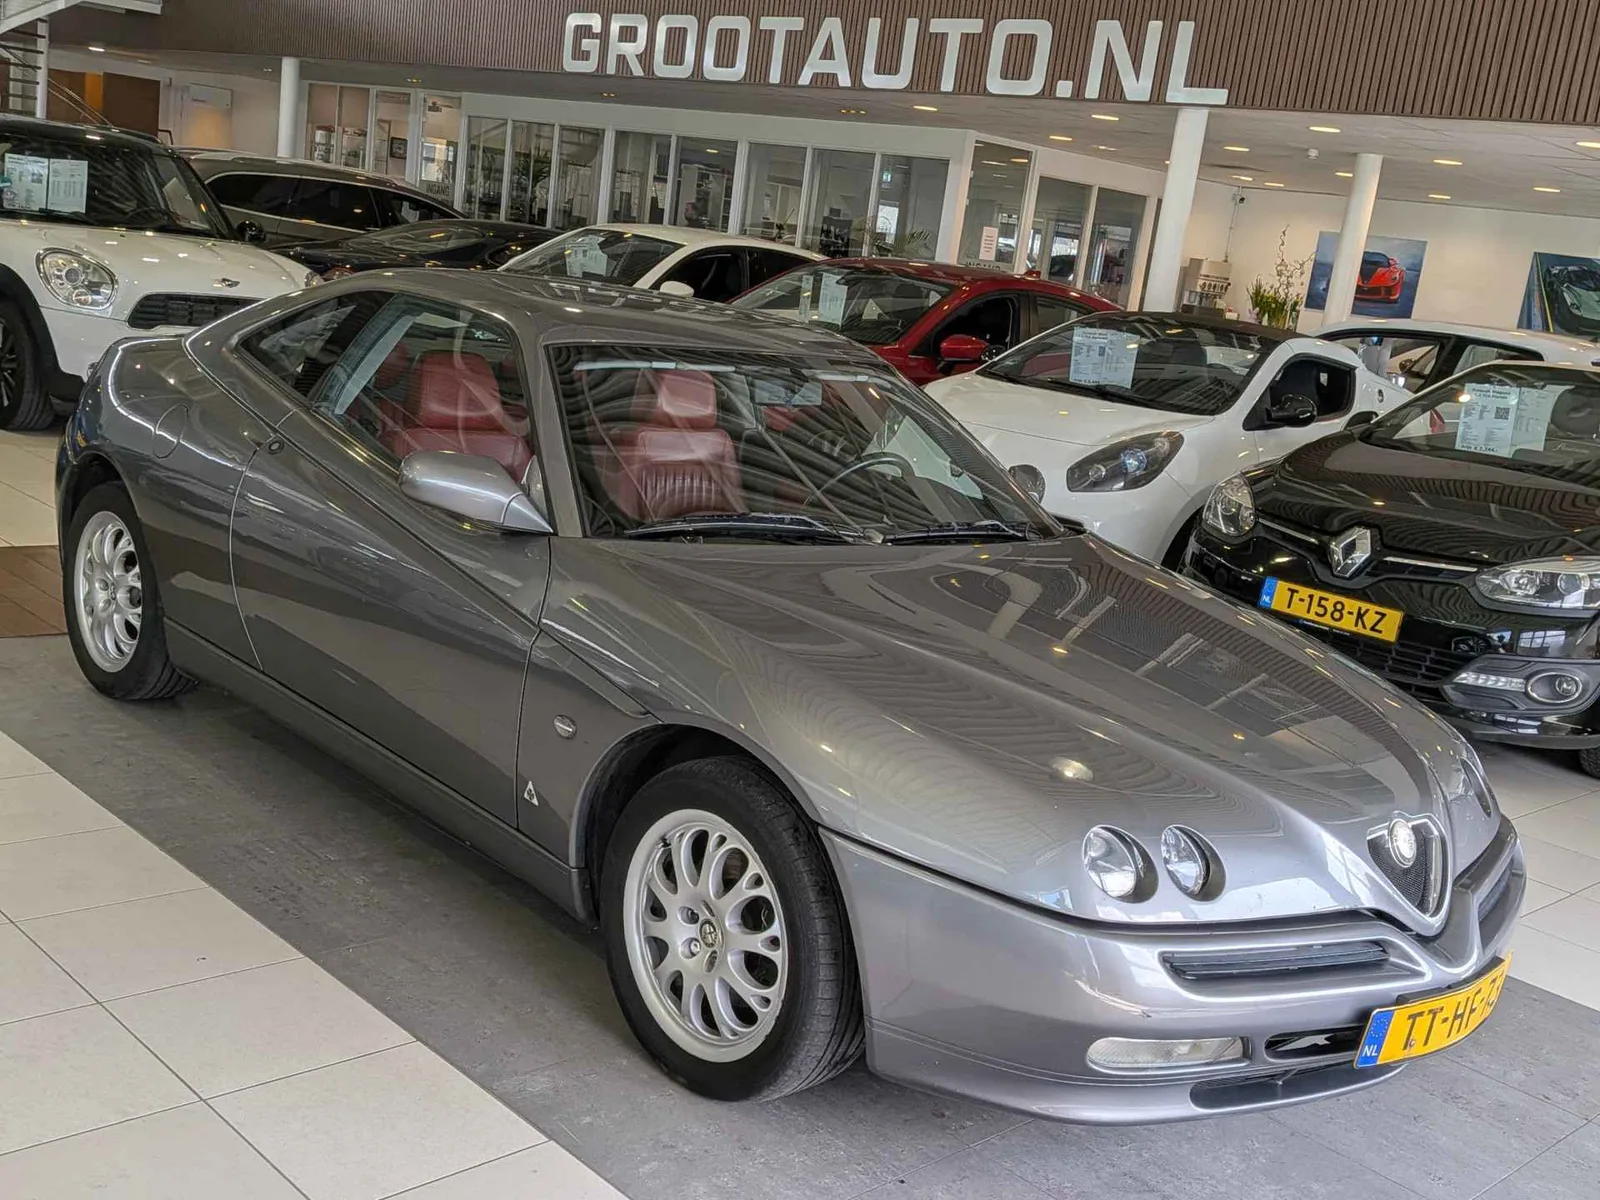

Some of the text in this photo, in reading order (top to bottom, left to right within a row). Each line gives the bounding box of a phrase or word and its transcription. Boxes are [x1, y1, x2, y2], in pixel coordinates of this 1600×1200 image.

[563, 12, 1228, 105] GROOTAUTO.NL
[1287, 588, 1387, 634] T-158-KZ
[1361, 1044, 1379, 1057] NL
